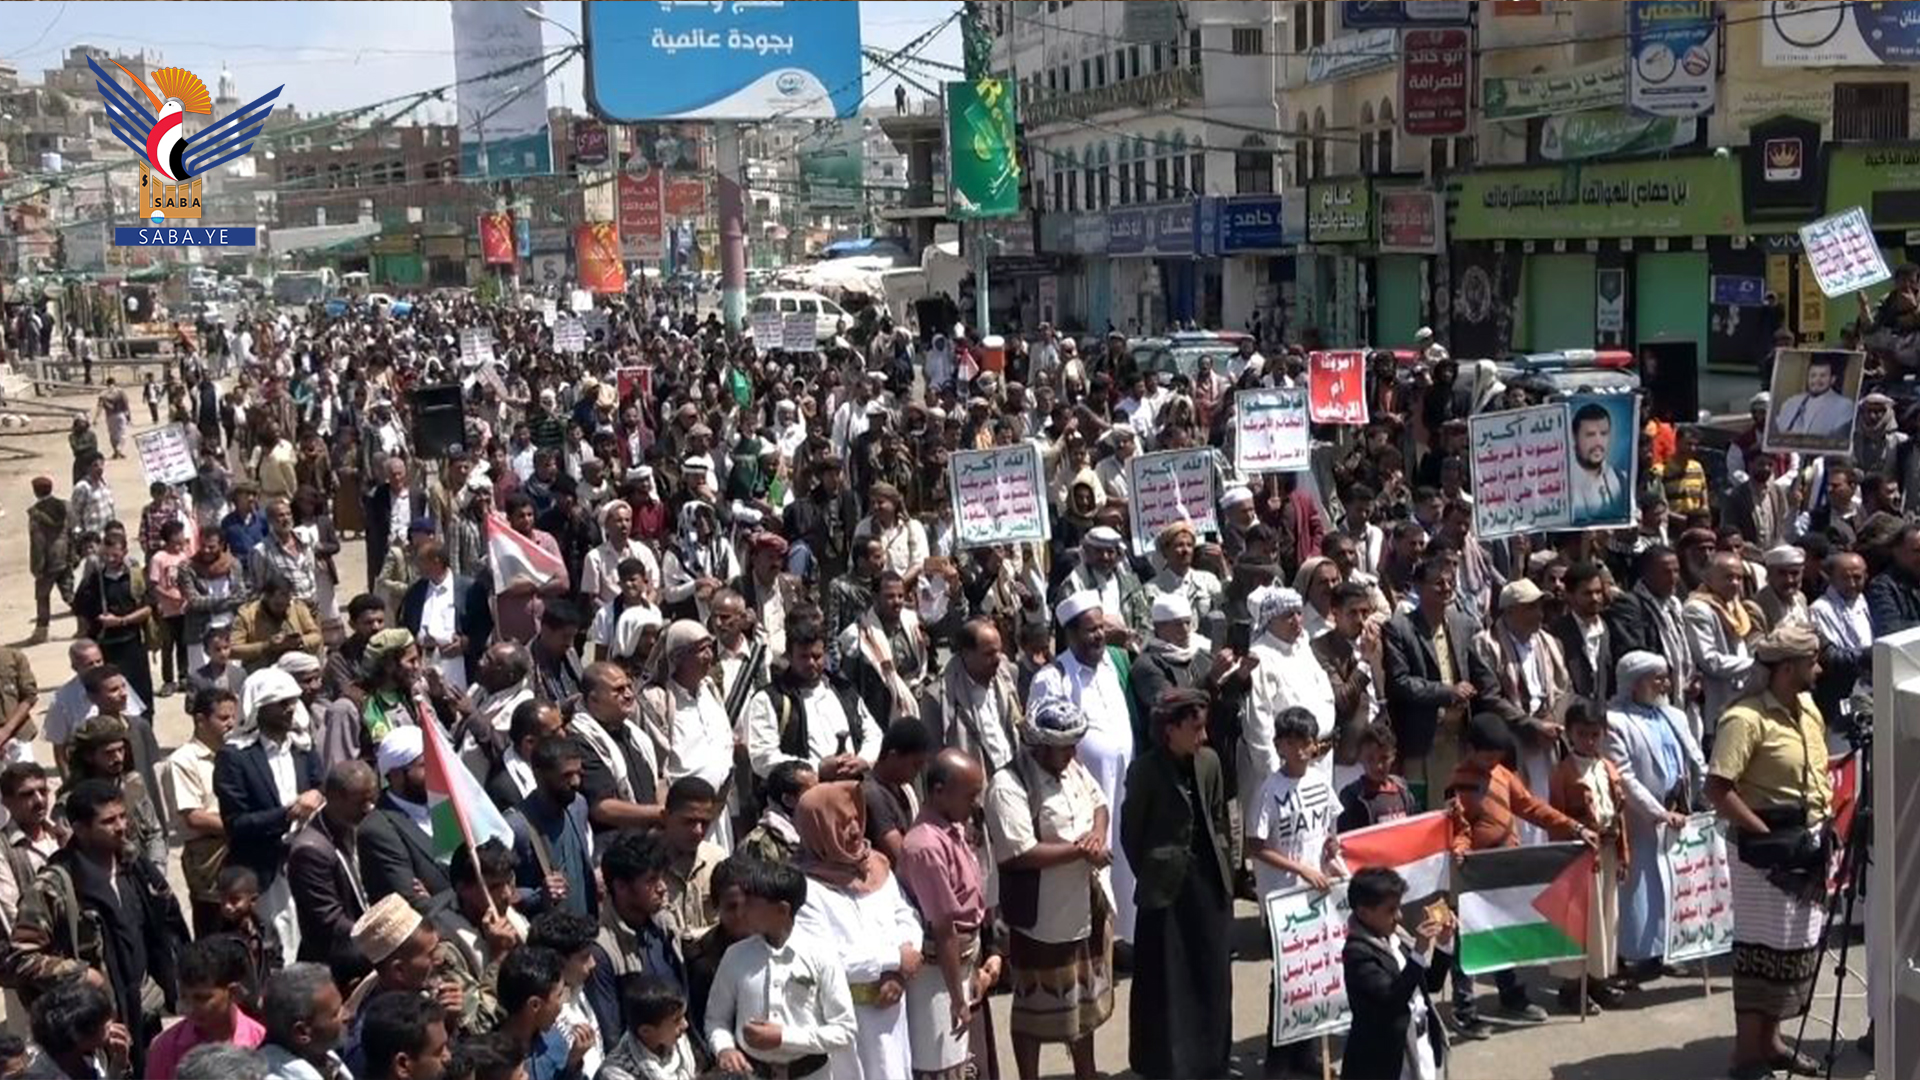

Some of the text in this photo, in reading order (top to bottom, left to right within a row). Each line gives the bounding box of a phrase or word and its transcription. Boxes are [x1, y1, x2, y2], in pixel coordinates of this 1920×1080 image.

[651, 27, 794, 56] بجودة عالمية
[1409, 72, 1464, 92] للصرافة
[1321, 186, 1353, 210] عالم
[1770, 235, 1801, 248] viv
[1530, 414, 1563, 434] الله
[1525, 440, 1564, 458] الموت
[1527, 459, 1565, 478] الموت
[1479, 479, 1565, 508] اللعنة على اليهود
[1529, 498, 1566, 525] النصر
